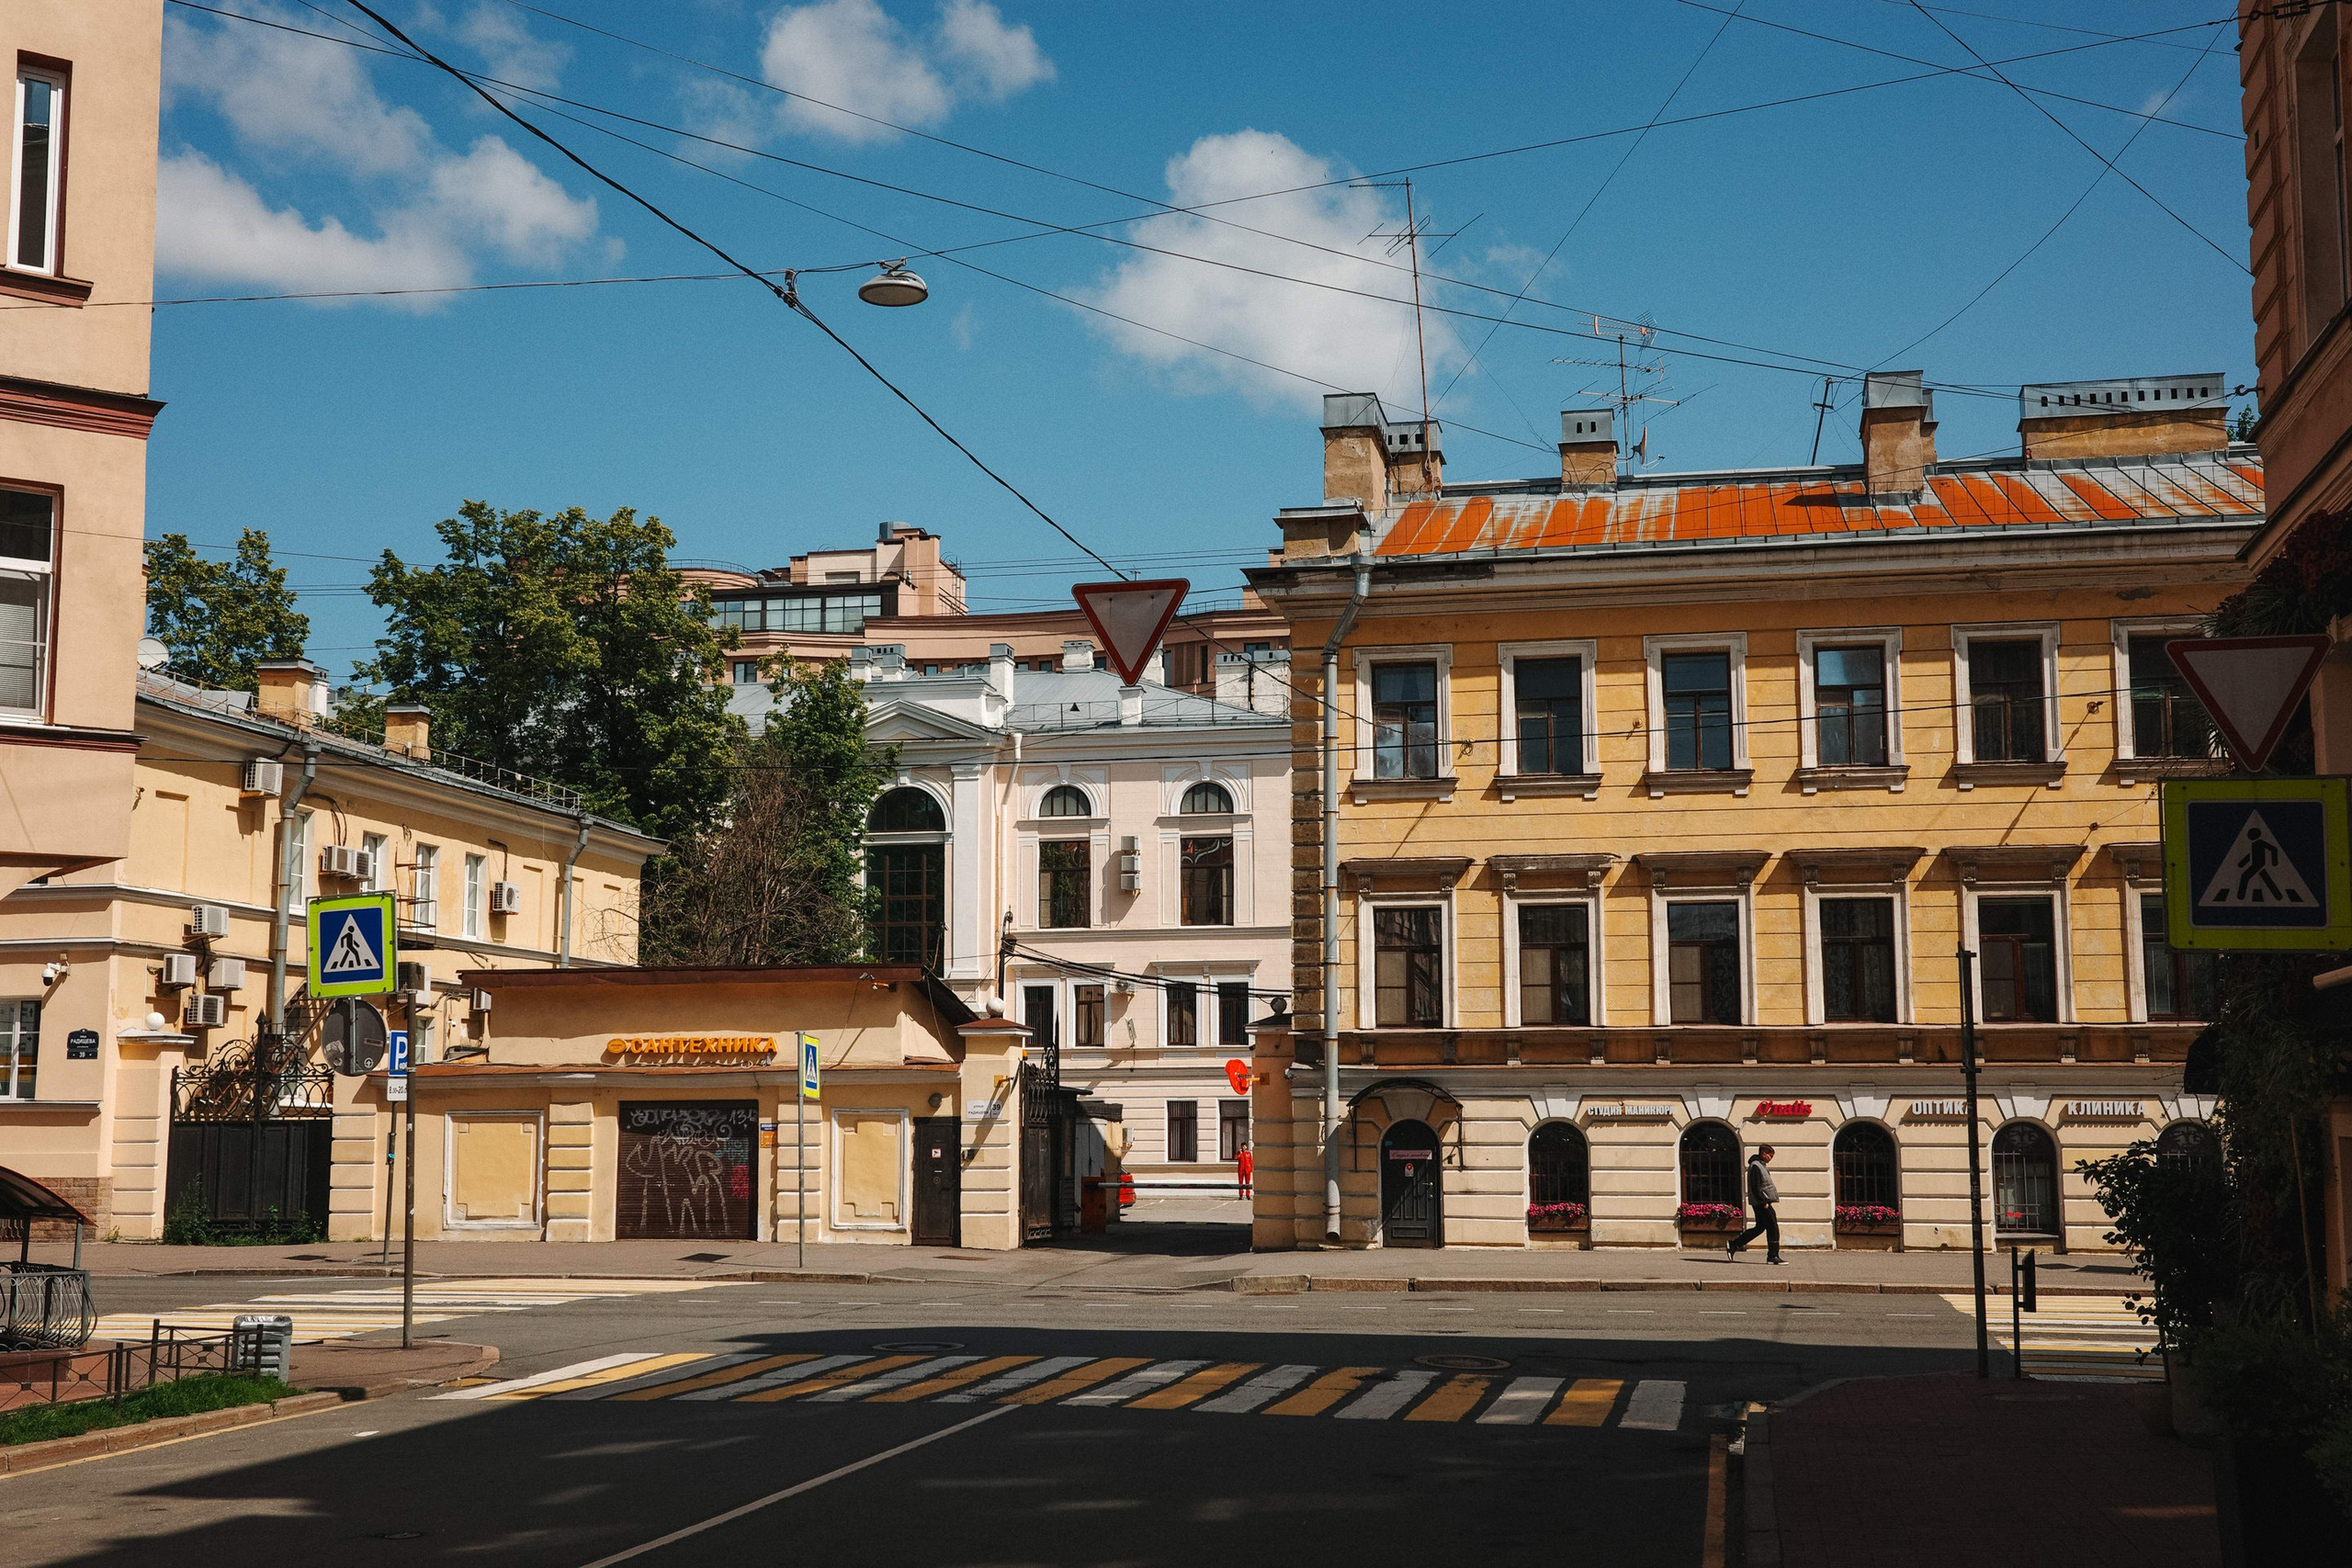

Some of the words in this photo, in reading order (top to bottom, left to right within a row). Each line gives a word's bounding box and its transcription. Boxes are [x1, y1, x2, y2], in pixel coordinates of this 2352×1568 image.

[630, 1037, 777, 1054] САНТЕХНИКА
[1588, 1106, 1623, 1116] СТУДИЯ
[1624, 1105, 1674, 1115] МАНИКЮРА
[1912, 1100, 1968, 1115] ОПТИК
[2067, 1100, 2146, 1115] КЛИНИКА
